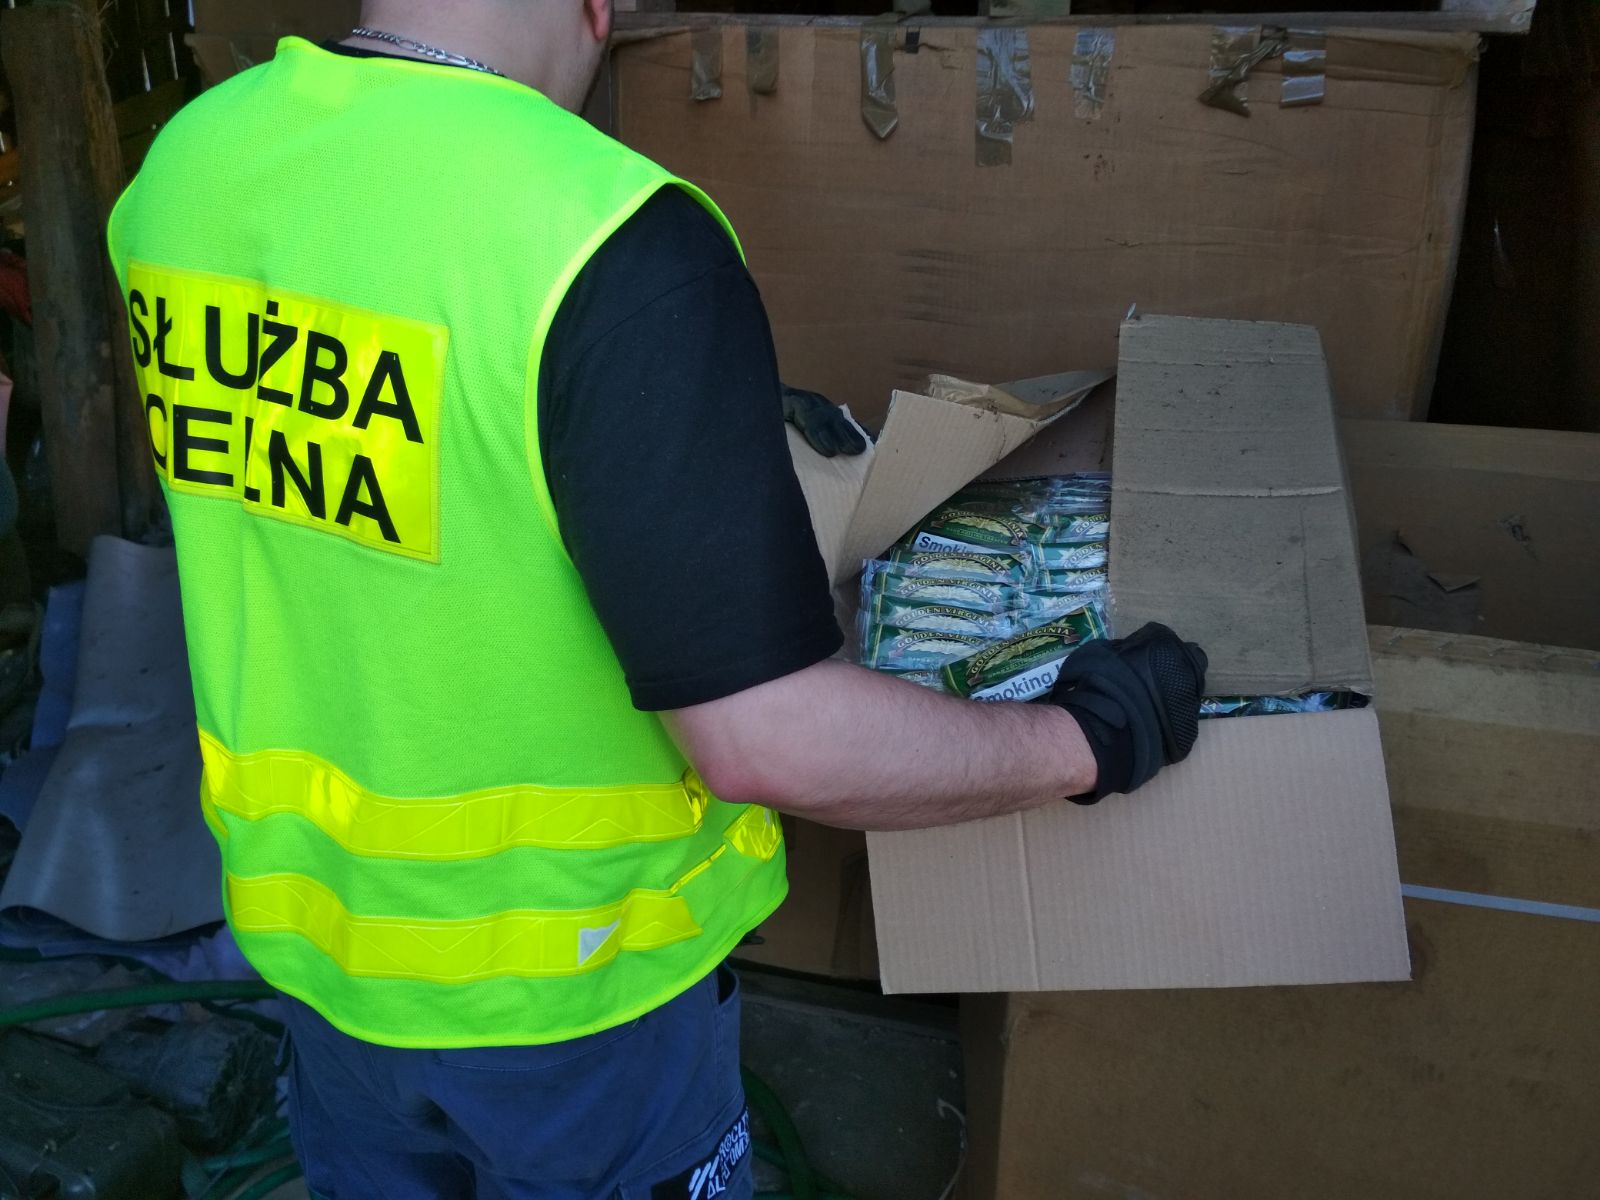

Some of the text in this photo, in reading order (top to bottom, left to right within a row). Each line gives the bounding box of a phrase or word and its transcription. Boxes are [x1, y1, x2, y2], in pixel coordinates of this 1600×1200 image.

[129, 288, 424, 444] SŁUŻBA
[145, 393, 402, 544] CELNA
[897, 632, 944, 648] GOLDEN
[970, 640, 1010, 674] GOLDEN
[1013, 627, 1070, 642] VIRGINIA
